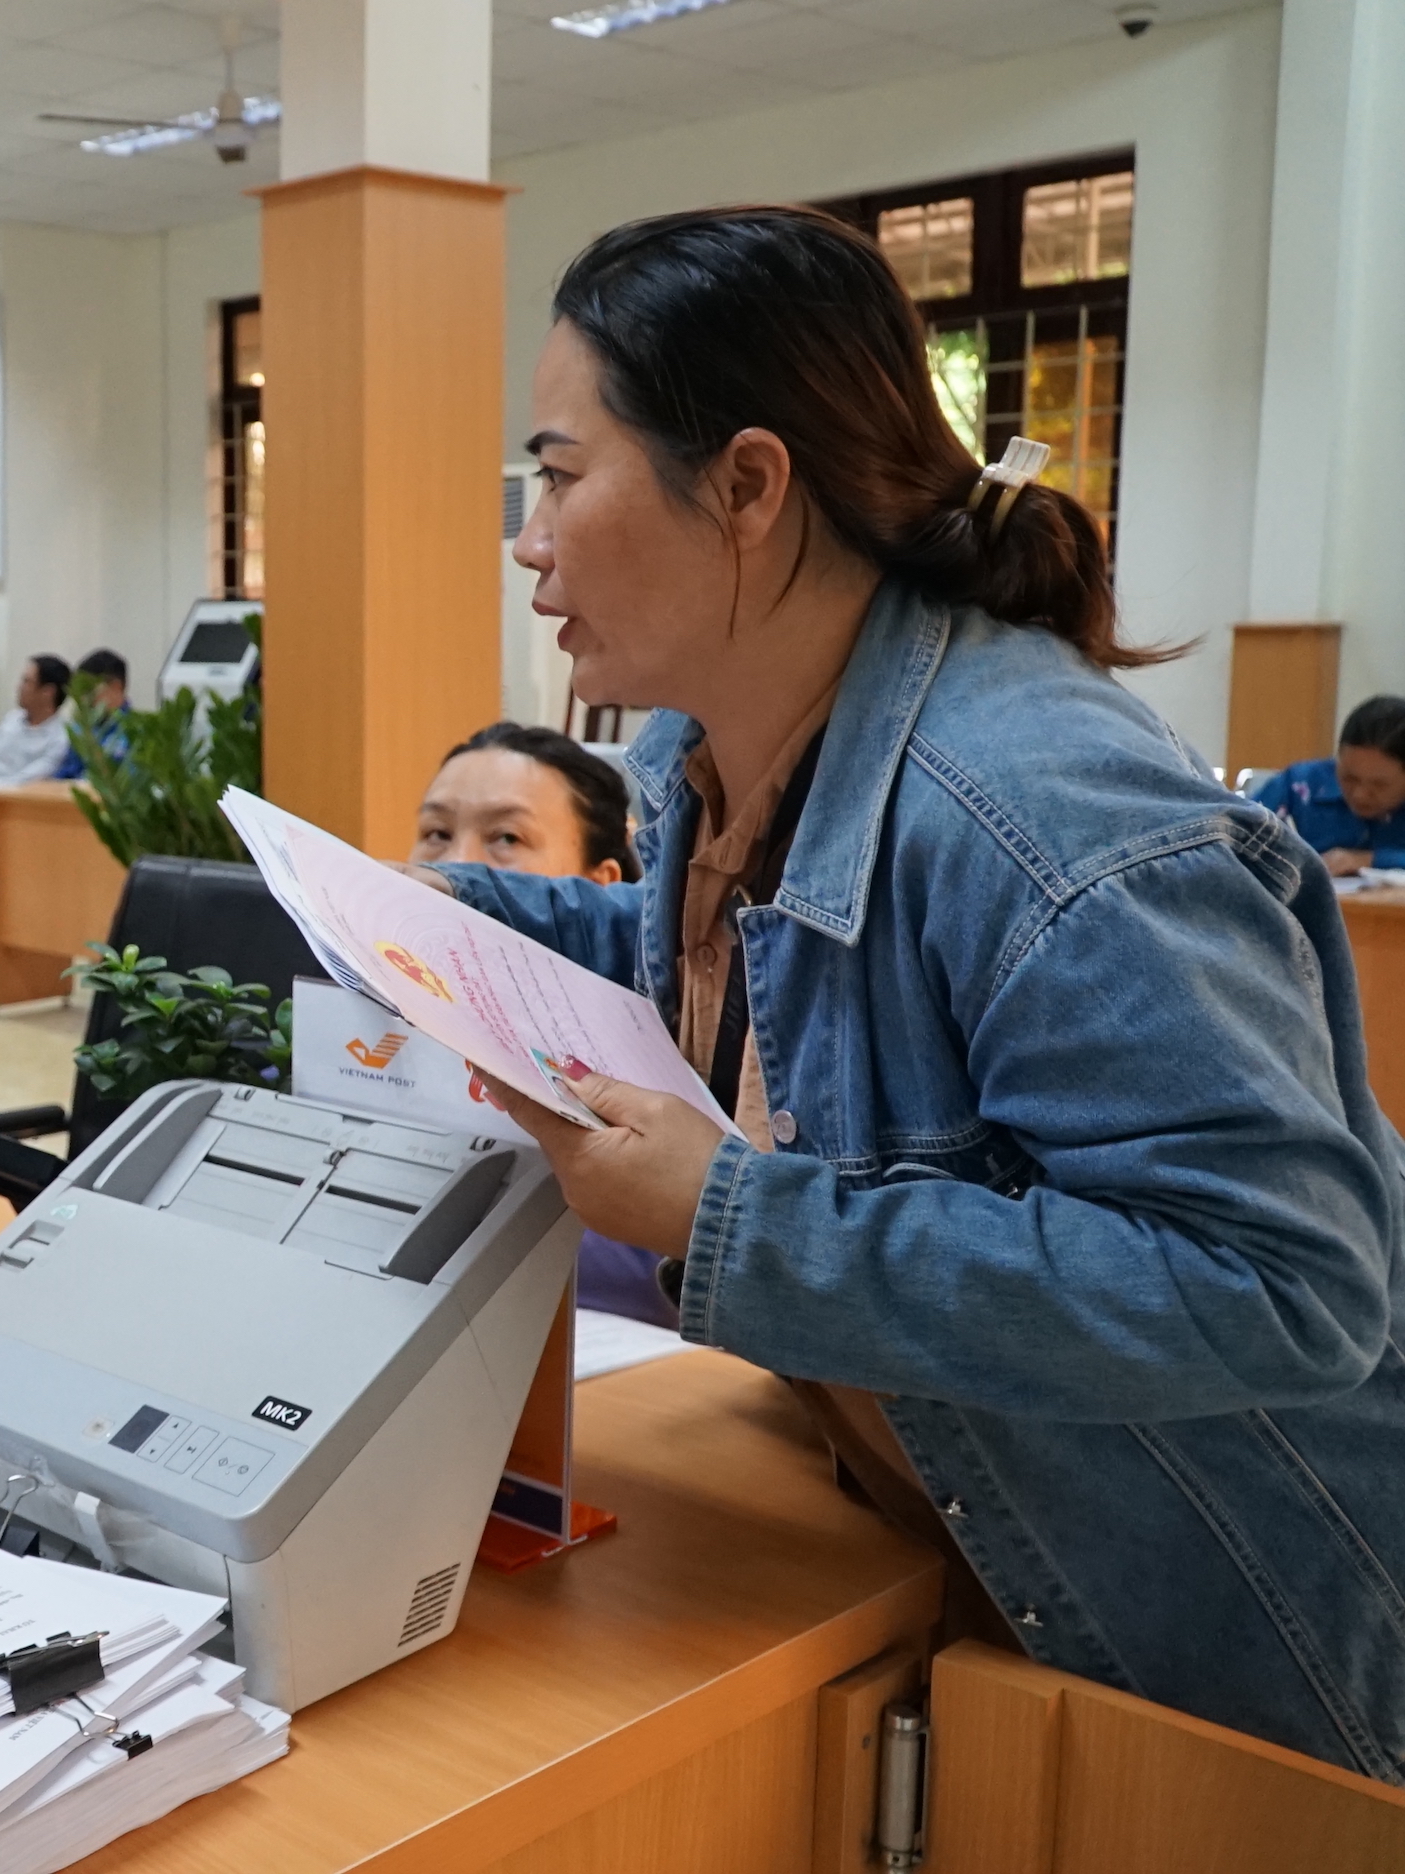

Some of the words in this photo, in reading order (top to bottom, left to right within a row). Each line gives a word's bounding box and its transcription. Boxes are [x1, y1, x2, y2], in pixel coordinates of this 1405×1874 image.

[339, 1067, 384, 1082] VIETNAM
[388, 1076, 416, 1088] POST
[260, 1401, 302, 1426] MK2
